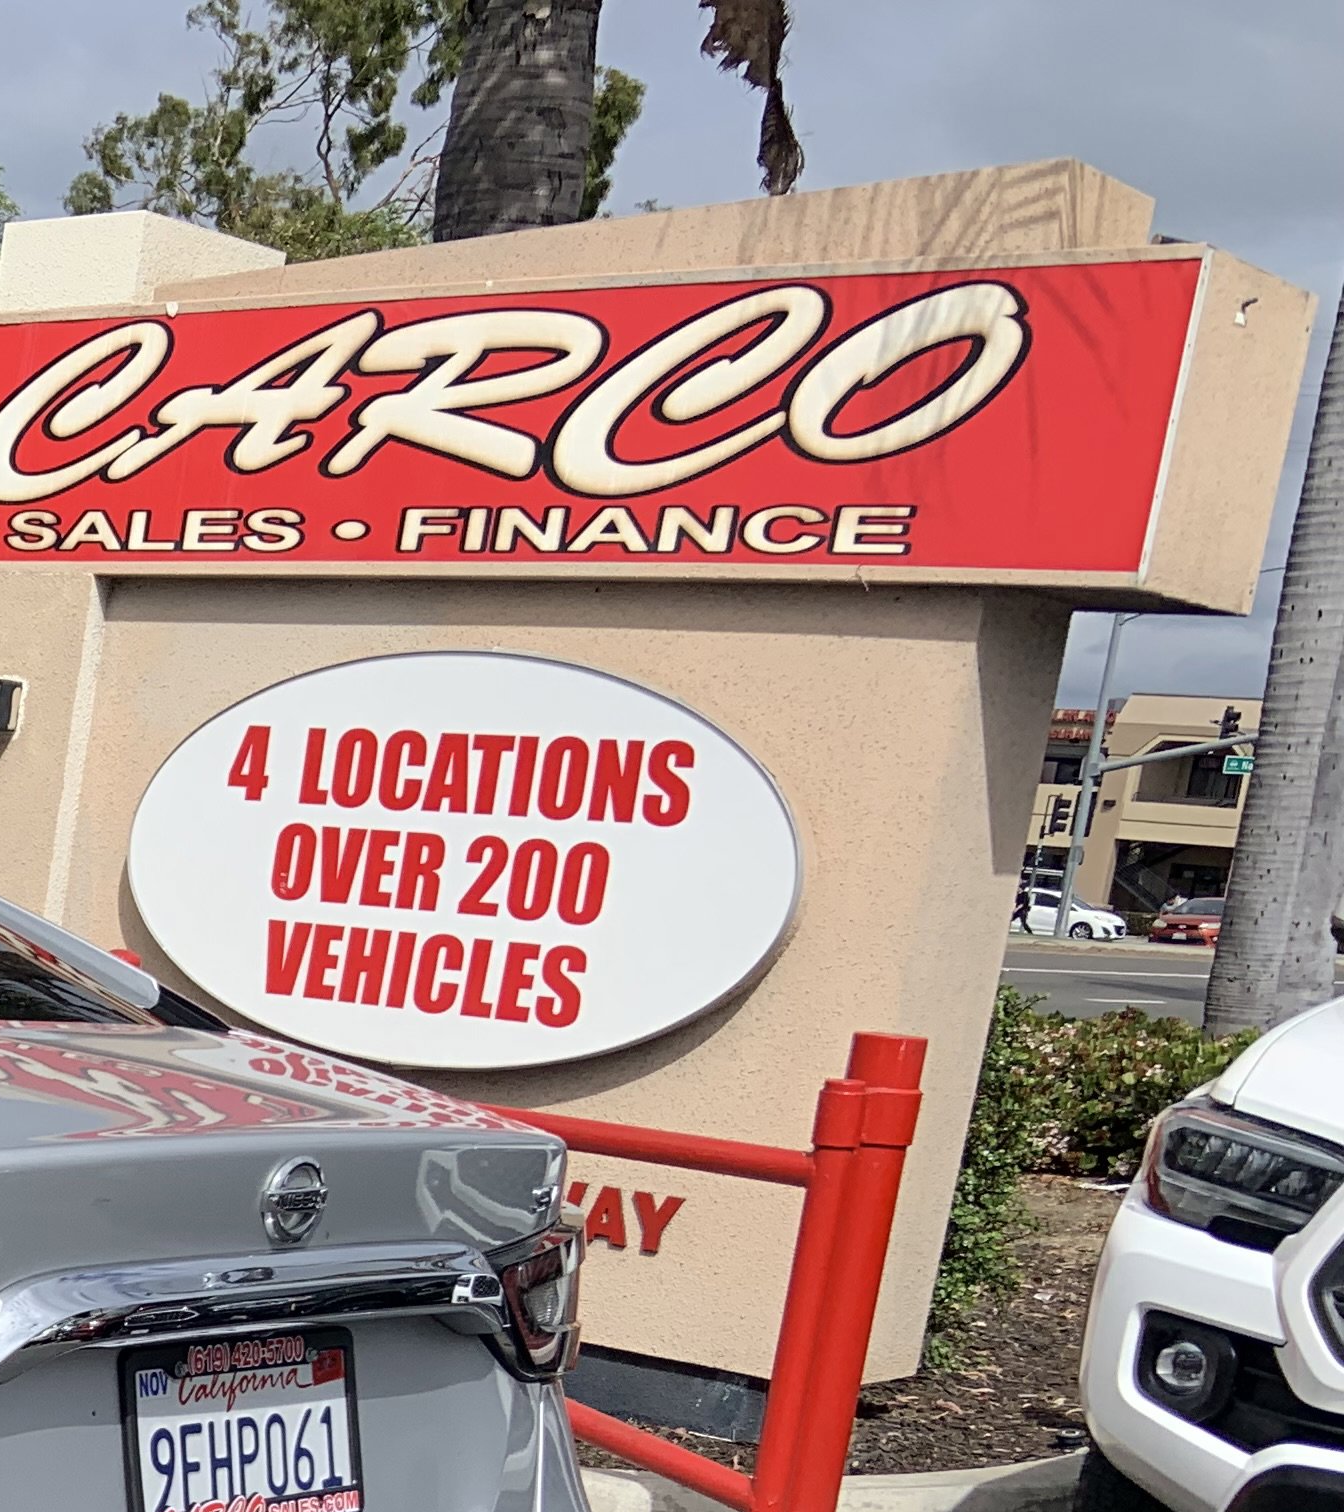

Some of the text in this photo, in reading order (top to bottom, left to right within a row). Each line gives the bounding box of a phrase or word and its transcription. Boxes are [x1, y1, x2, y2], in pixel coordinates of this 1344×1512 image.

[4, 505, 917, 555] SALES FINANCE
[227, 725, 696, 828] 4 LOCATIONS
[271, 823, 611, 926] OVER 200
[265, 919, 587, 1029] VEHICLES
[187, 1341, 231, 1376] (619)
[231, 1335, 305, 1368] 420-5700
[139, 1370, 169, 1398] NOV
[178, 1366, 314, 1413] California
